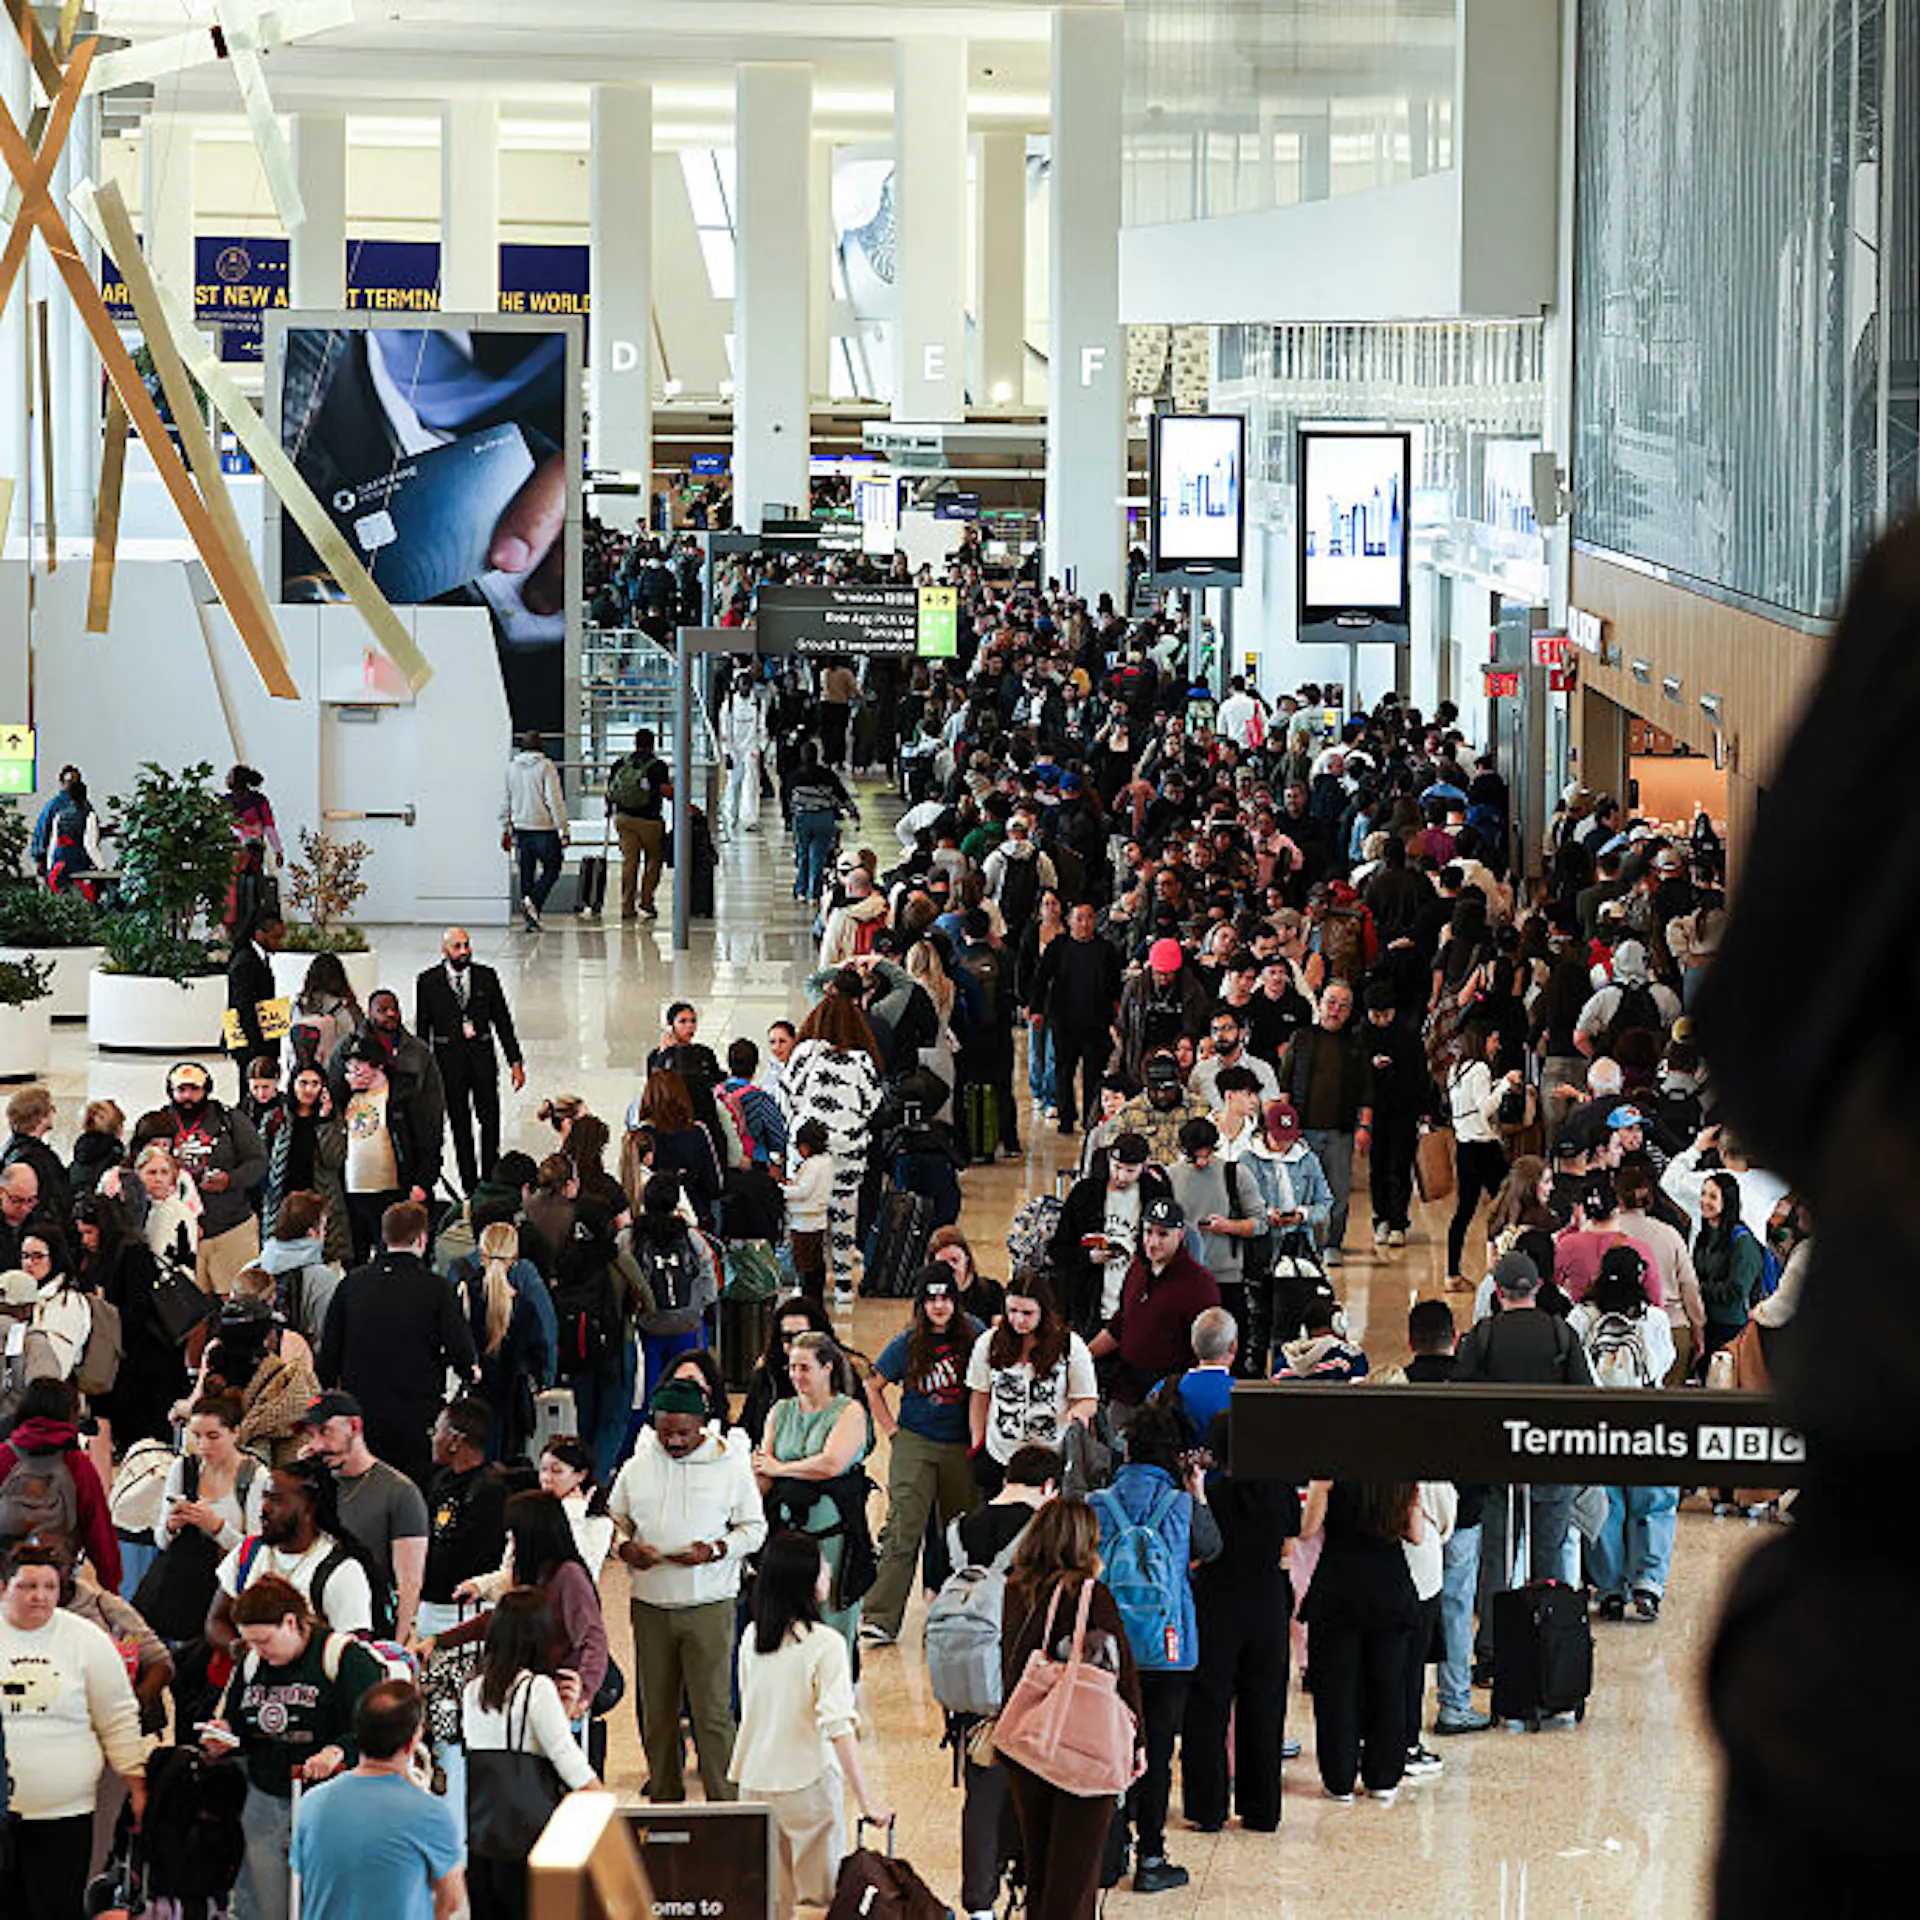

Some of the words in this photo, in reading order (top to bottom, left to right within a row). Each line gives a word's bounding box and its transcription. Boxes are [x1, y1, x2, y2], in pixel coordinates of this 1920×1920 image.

[224, 285, 271, 307] NEW
[346, 288, 361, 308] T
[364, 288, 440, 310] TERMIN
[612, 341, 638, 371] D
[924, 345, 946, 380] E
[1081, 347, 1106, 386] F
[1503, 1420, 1688, 1457] Terminals
[699, 1899, 724, 1917] to
